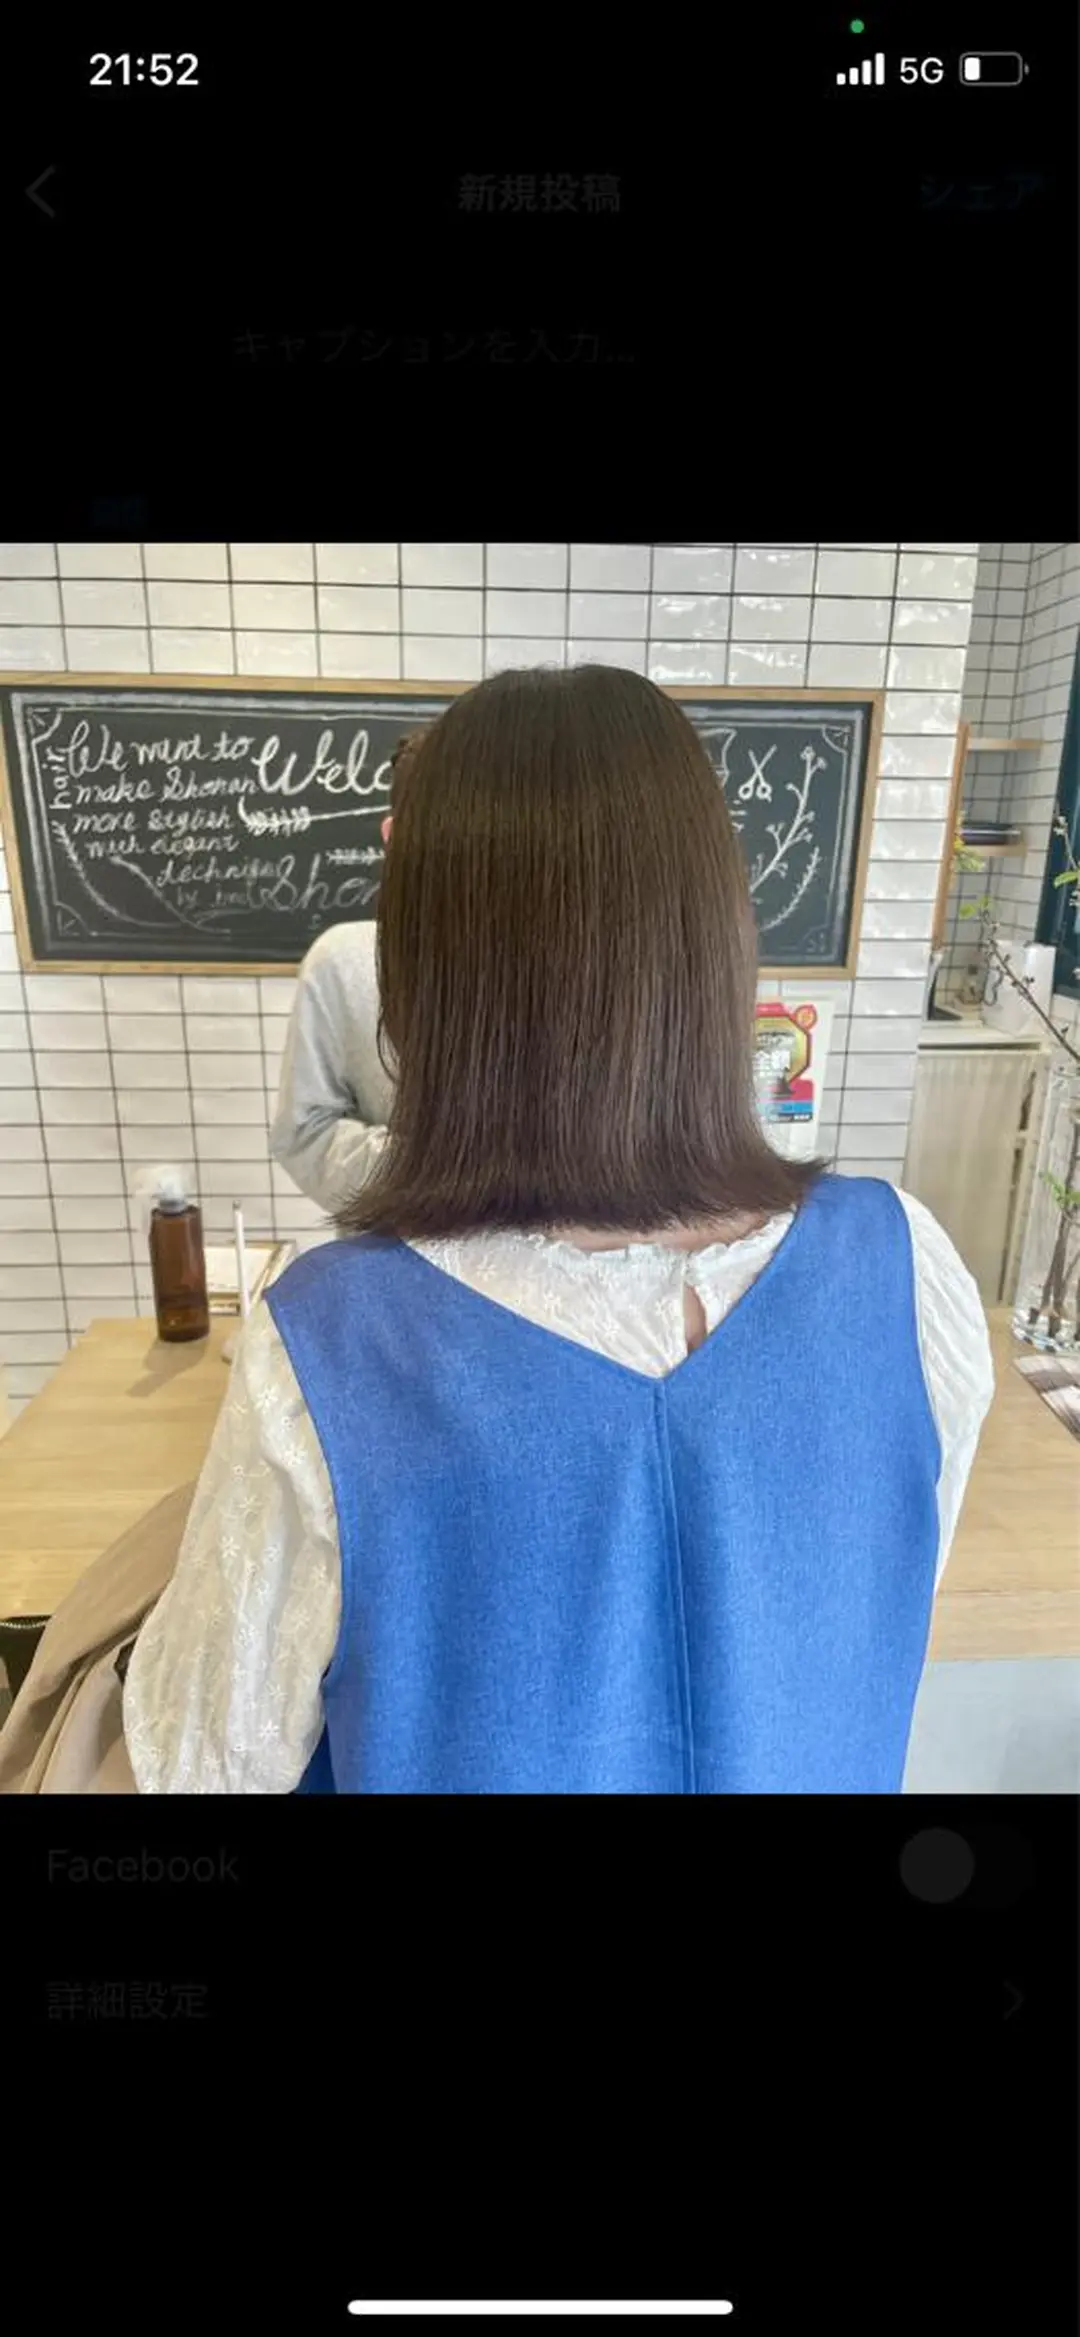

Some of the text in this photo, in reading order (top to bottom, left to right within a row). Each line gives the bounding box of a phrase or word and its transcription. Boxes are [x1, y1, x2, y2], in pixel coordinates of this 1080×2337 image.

[66, 720, 128, 778] We
[210, 730, 256, 762] to
[42, 747, 73, 810] hair
[74, 772, 156, 805] make
[72, 811, 139, 834] more
